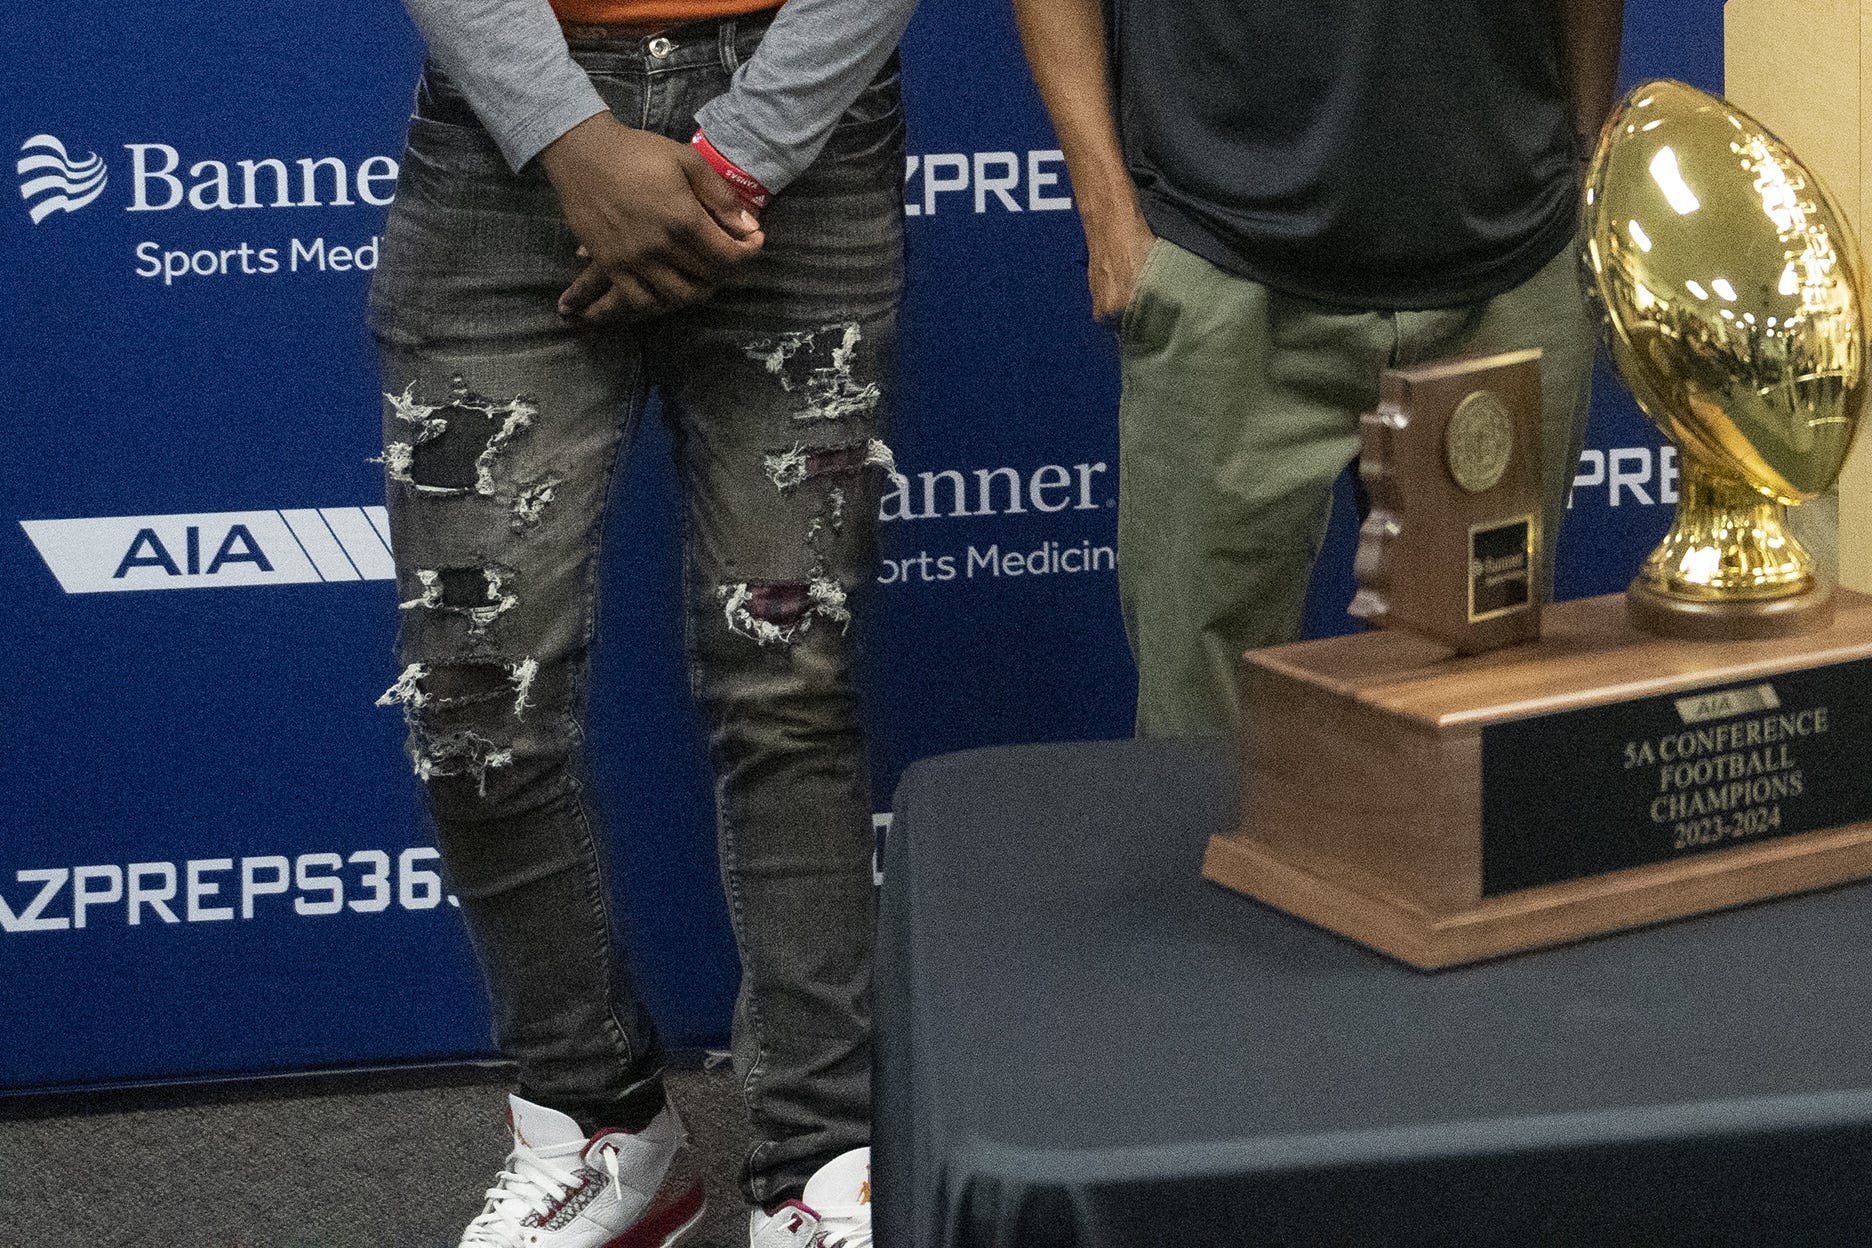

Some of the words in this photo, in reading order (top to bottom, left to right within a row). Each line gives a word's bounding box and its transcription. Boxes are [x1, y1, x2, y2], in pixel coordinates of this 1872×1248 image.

[135, 241, 279, 285] Sports
[113, 523, 275, 580] AIA
[1624, 740, 1656, 769] 5A
[1658, 706, 1829, 762] CONFERENCE
[1659, 743, 1796, 792] FOOTBALL
[1650, 769, 1803, 823] CHAMPIONS
[1674, 802, 1782, 849] 2023-2024
[0, 847, 460, 933] ZPREPS36
